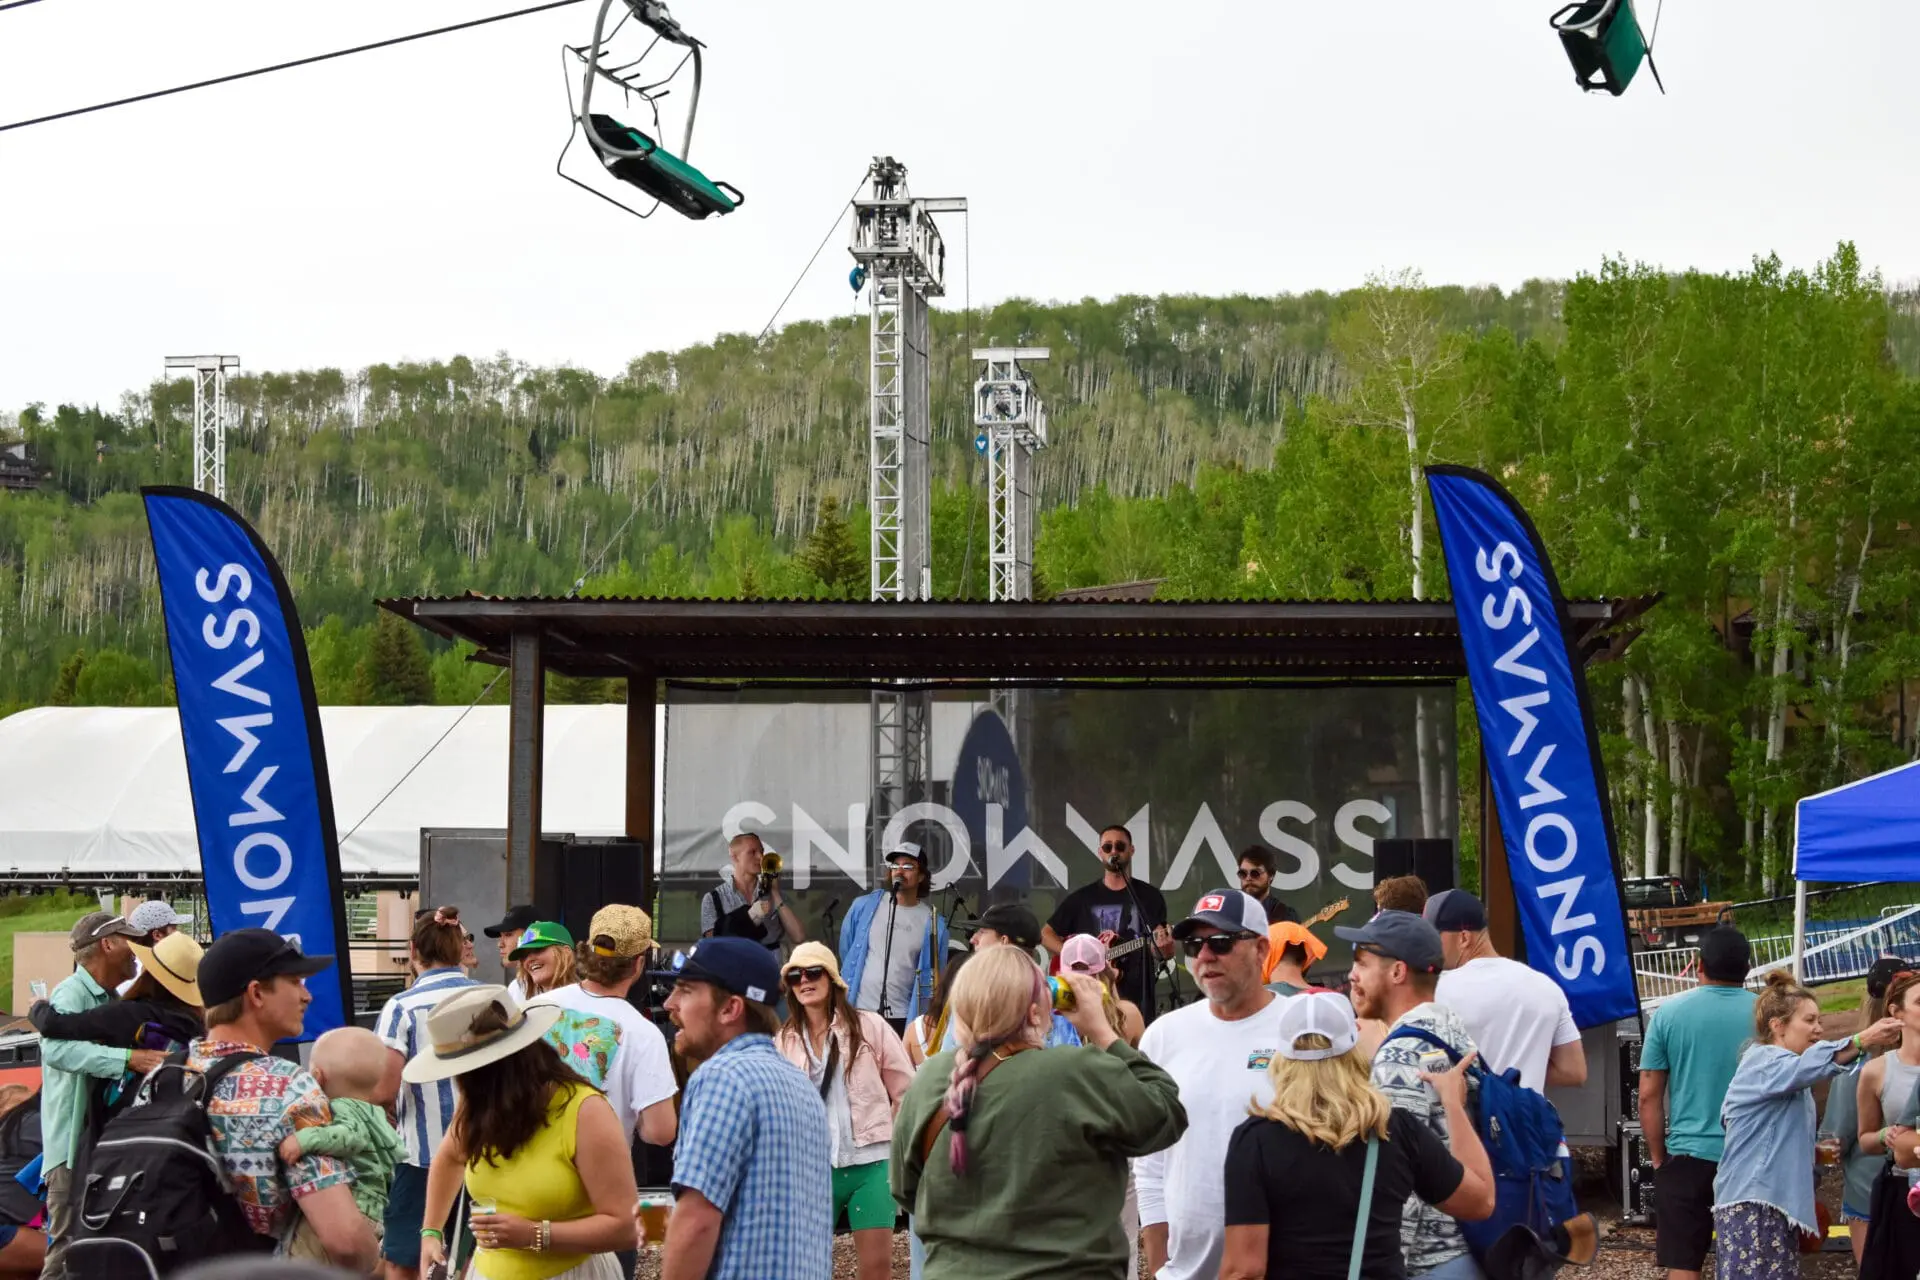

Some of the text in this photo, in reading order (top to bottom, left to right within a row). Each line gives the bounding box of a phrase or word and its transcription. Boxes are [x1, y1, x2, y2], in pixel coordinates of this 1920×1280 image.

[195, 562, 304, 955] NOWMASS
[719, 798, 1393, 891] SNOWMASS
[1475, 540, 1606, 982] SNOWMASS
